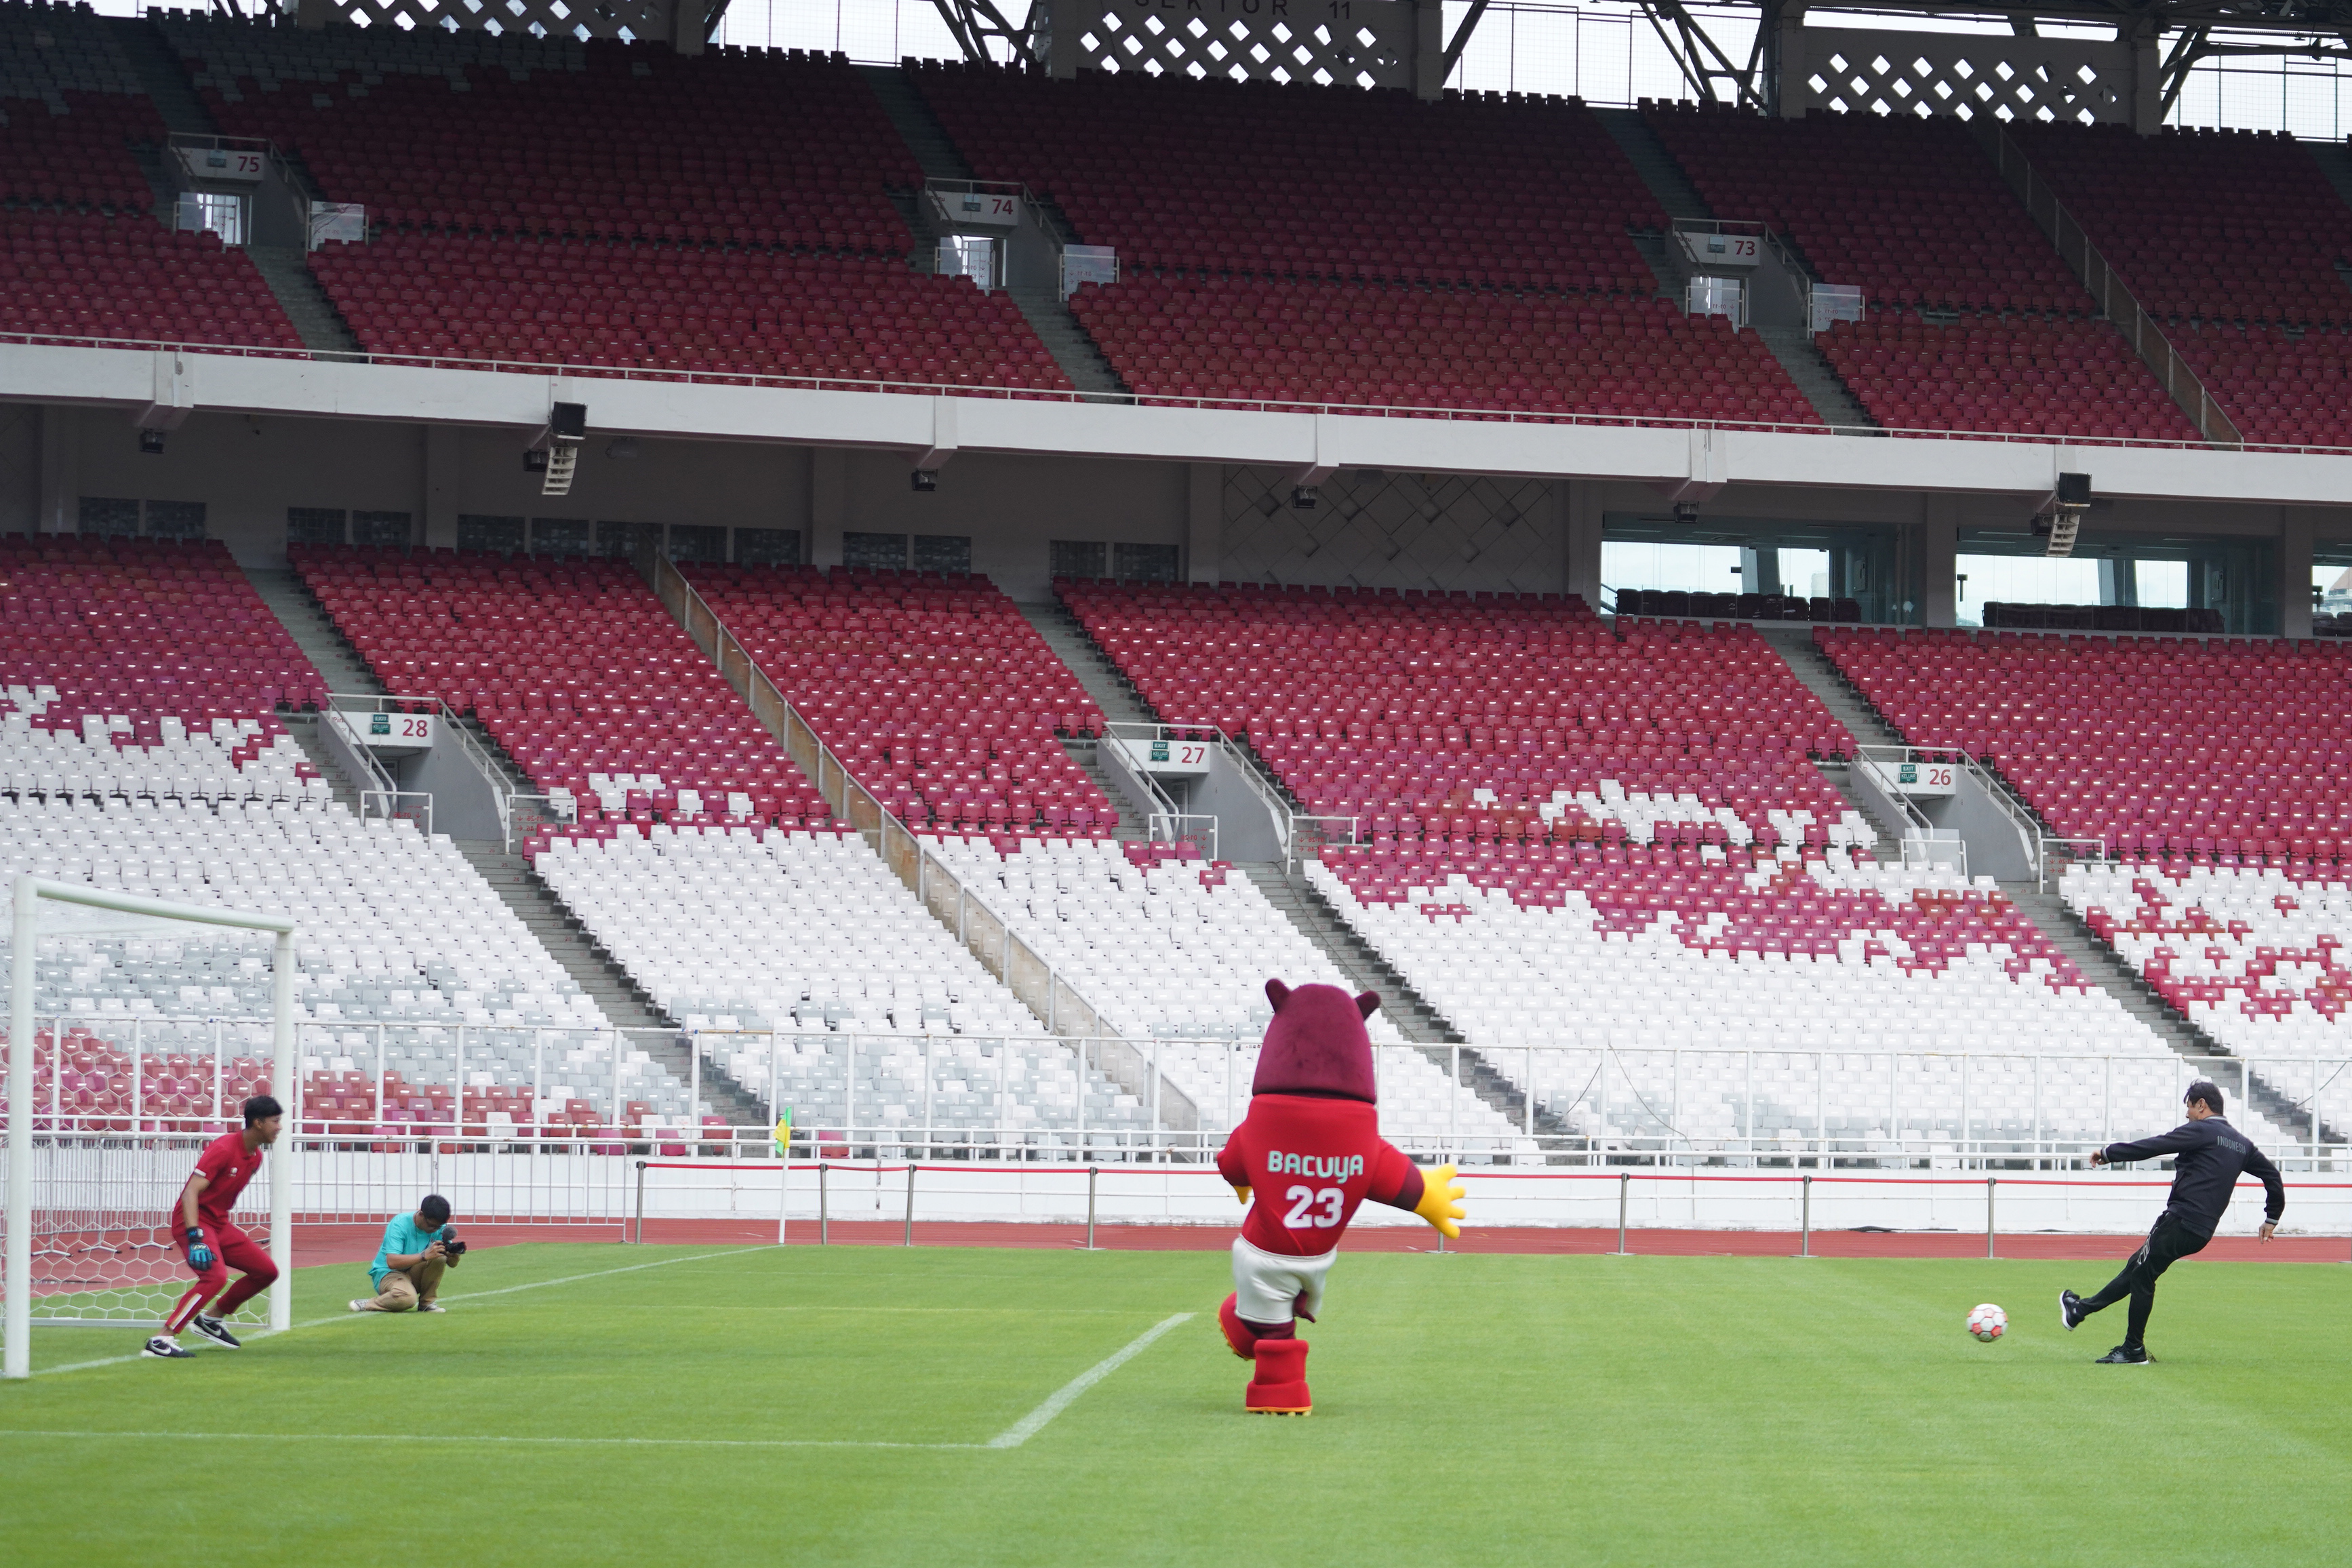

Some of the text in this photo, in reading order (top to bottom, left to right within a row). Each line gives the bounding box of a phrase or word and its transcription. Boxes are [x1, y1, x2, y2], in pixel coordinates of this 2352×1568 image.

[1329, 1, 1351, 19] 11
[238, 156, 260, 172] 75
[992, 199, 1014, 215] 74
[1735, 240, 1755, 256] 73
[403, 719, 428, 737] 28
[1182, 746, 1205, 763] 27
[1930, 769, 1951, 785] 26
[2217, 1135, 2246, 1154] INDONESIA
[1283, 1185, 1344, 1228] 23
